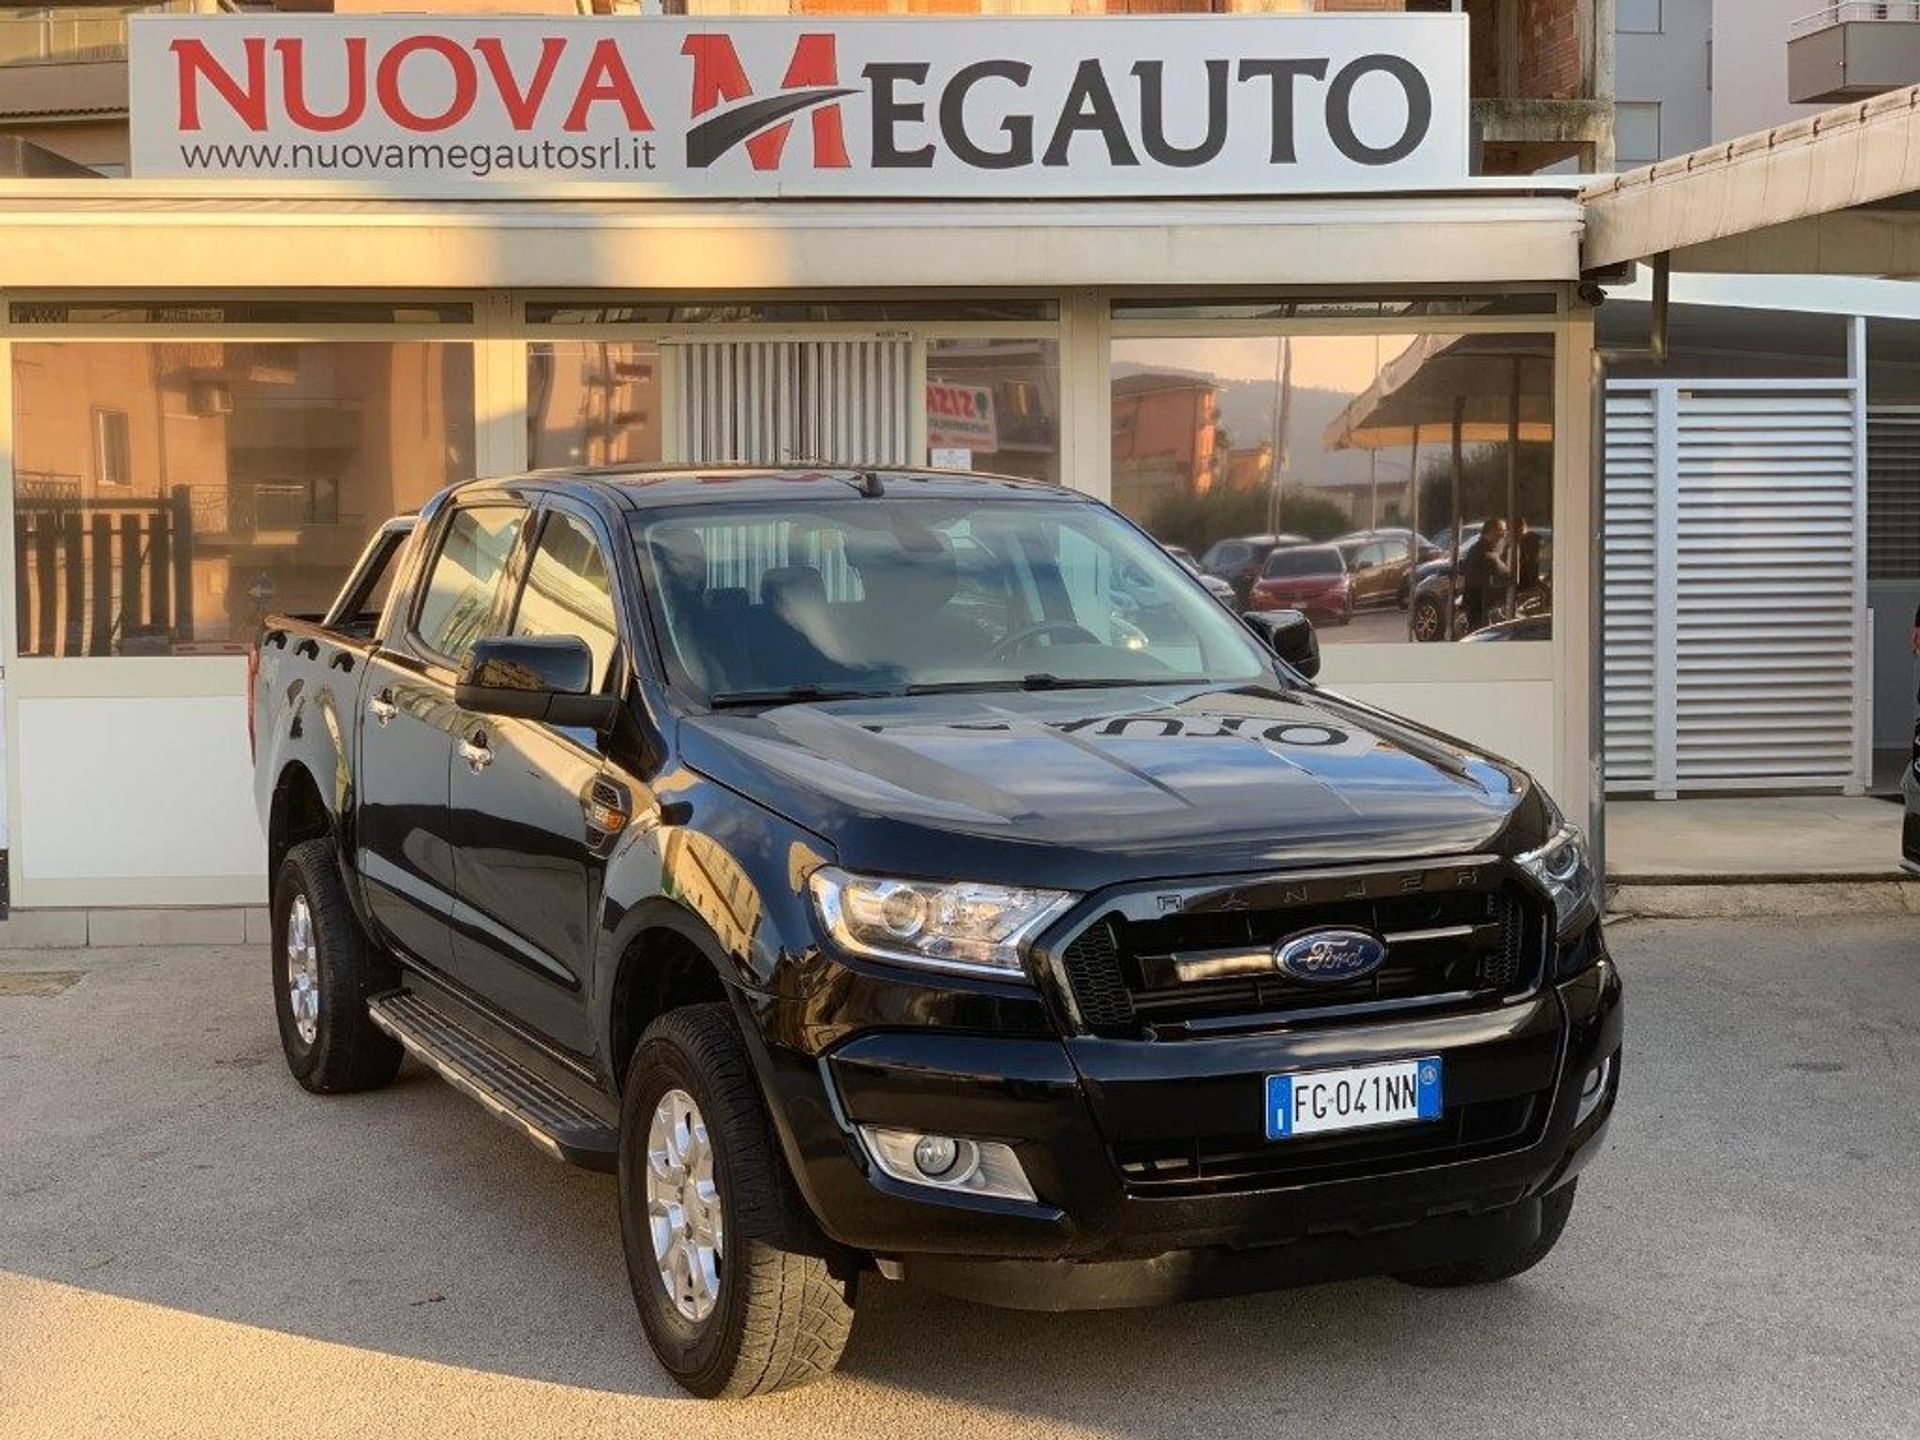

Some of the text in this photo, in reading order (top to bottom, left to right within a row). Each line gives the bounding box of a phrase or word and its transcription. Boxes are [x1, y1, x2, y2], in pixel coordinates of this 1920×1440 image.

[168, 33, 1433, 170] NUOVA MEGAUTO
[180, 138, 657, 176] www.nuovamegautosrl.it
[1297, 939, 1364, 971] Ford
